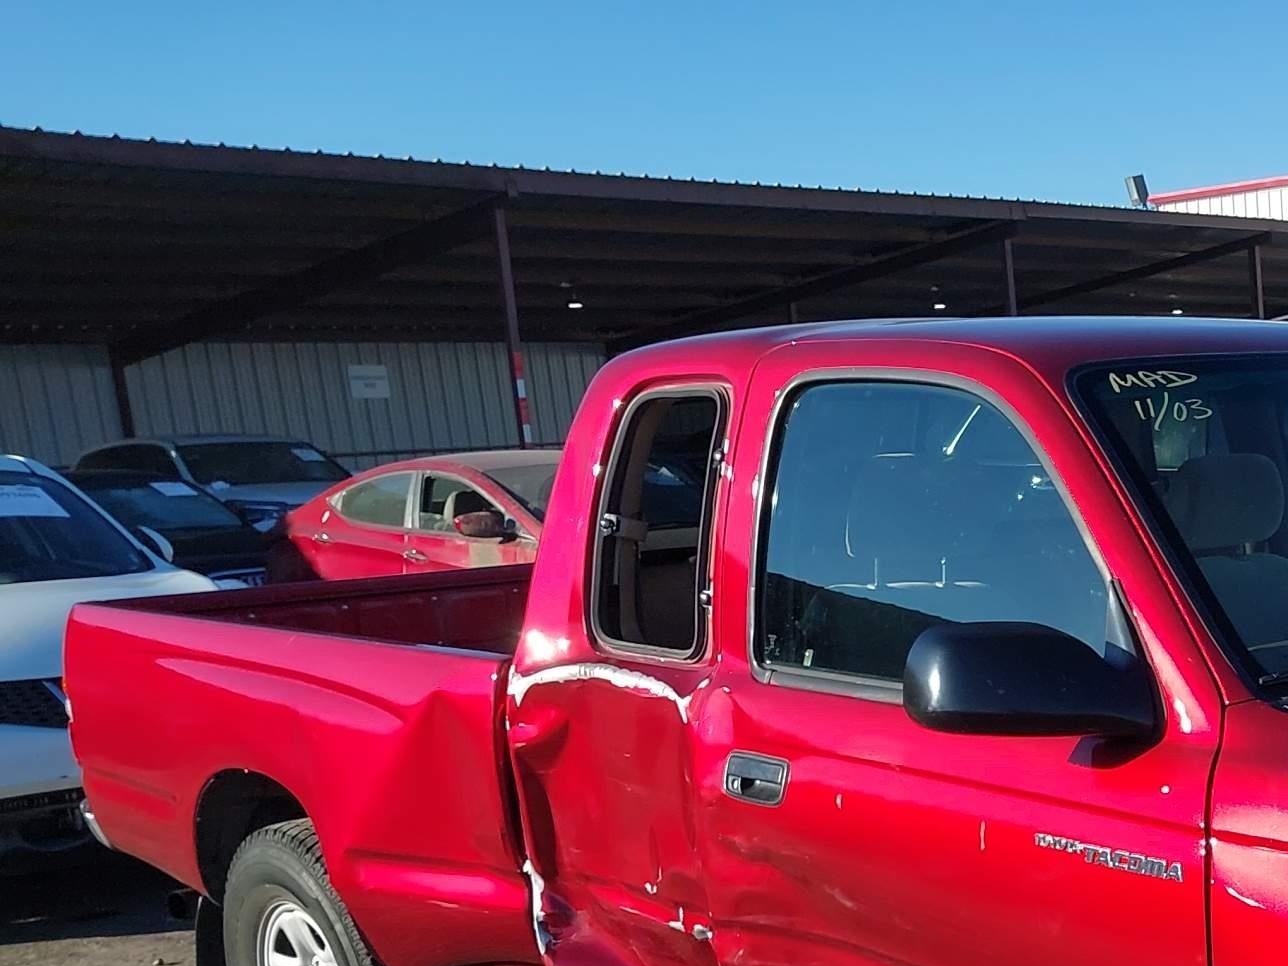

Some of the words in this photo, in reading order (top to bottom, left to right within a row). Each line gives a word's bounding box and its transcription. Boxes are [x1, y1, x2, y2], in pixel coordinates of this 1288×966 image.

[1109, 370, 1198, 393] MAD
[1134, 391, 1213, 431] 11/03
[1083, 844, 1183, 881] TACOMA
